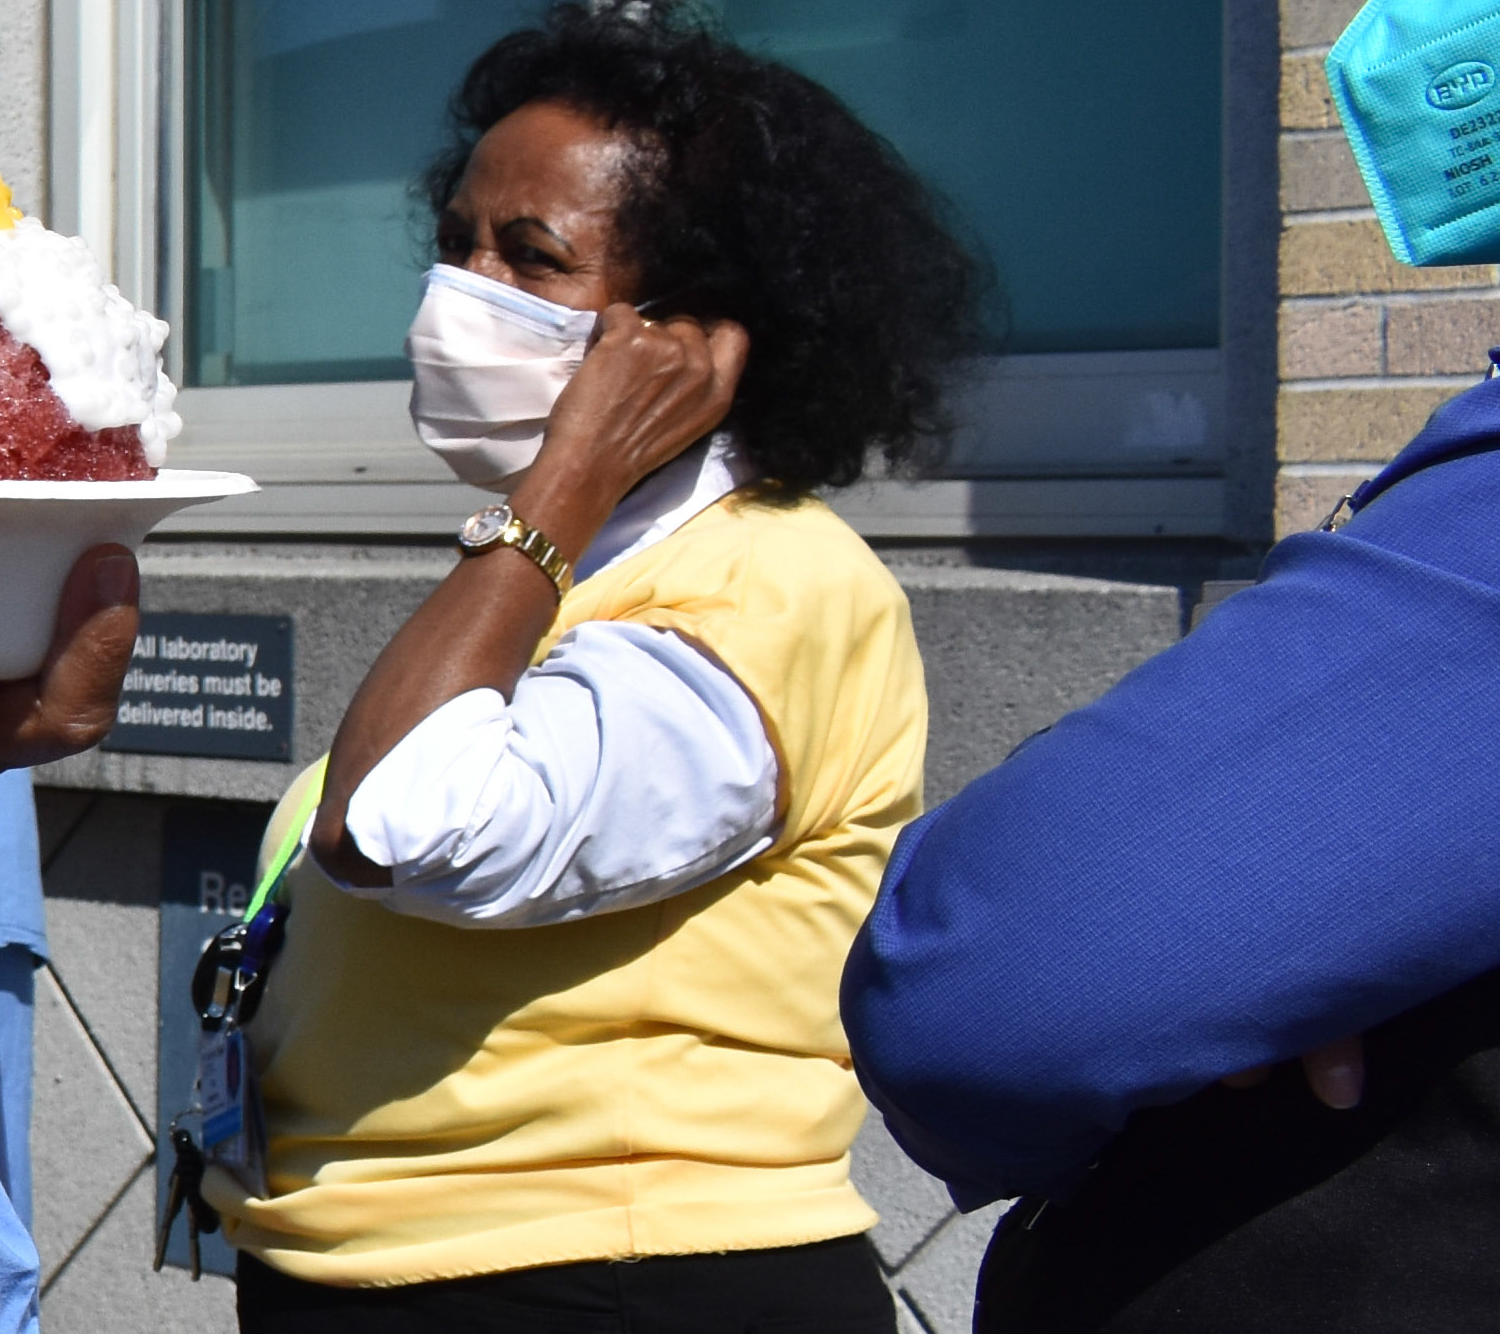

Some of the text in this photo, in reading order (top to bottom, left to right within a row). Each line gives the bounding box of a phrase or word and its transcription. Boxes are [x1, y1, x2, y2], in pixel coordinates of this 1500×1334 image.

[1444, 153, 1493, 182] NIOSH
[133, 634, 258, 667] All laboratory
[122, 668, 282, 698] eliveries must be
[117, 701, 273, 731] delivered inside.
